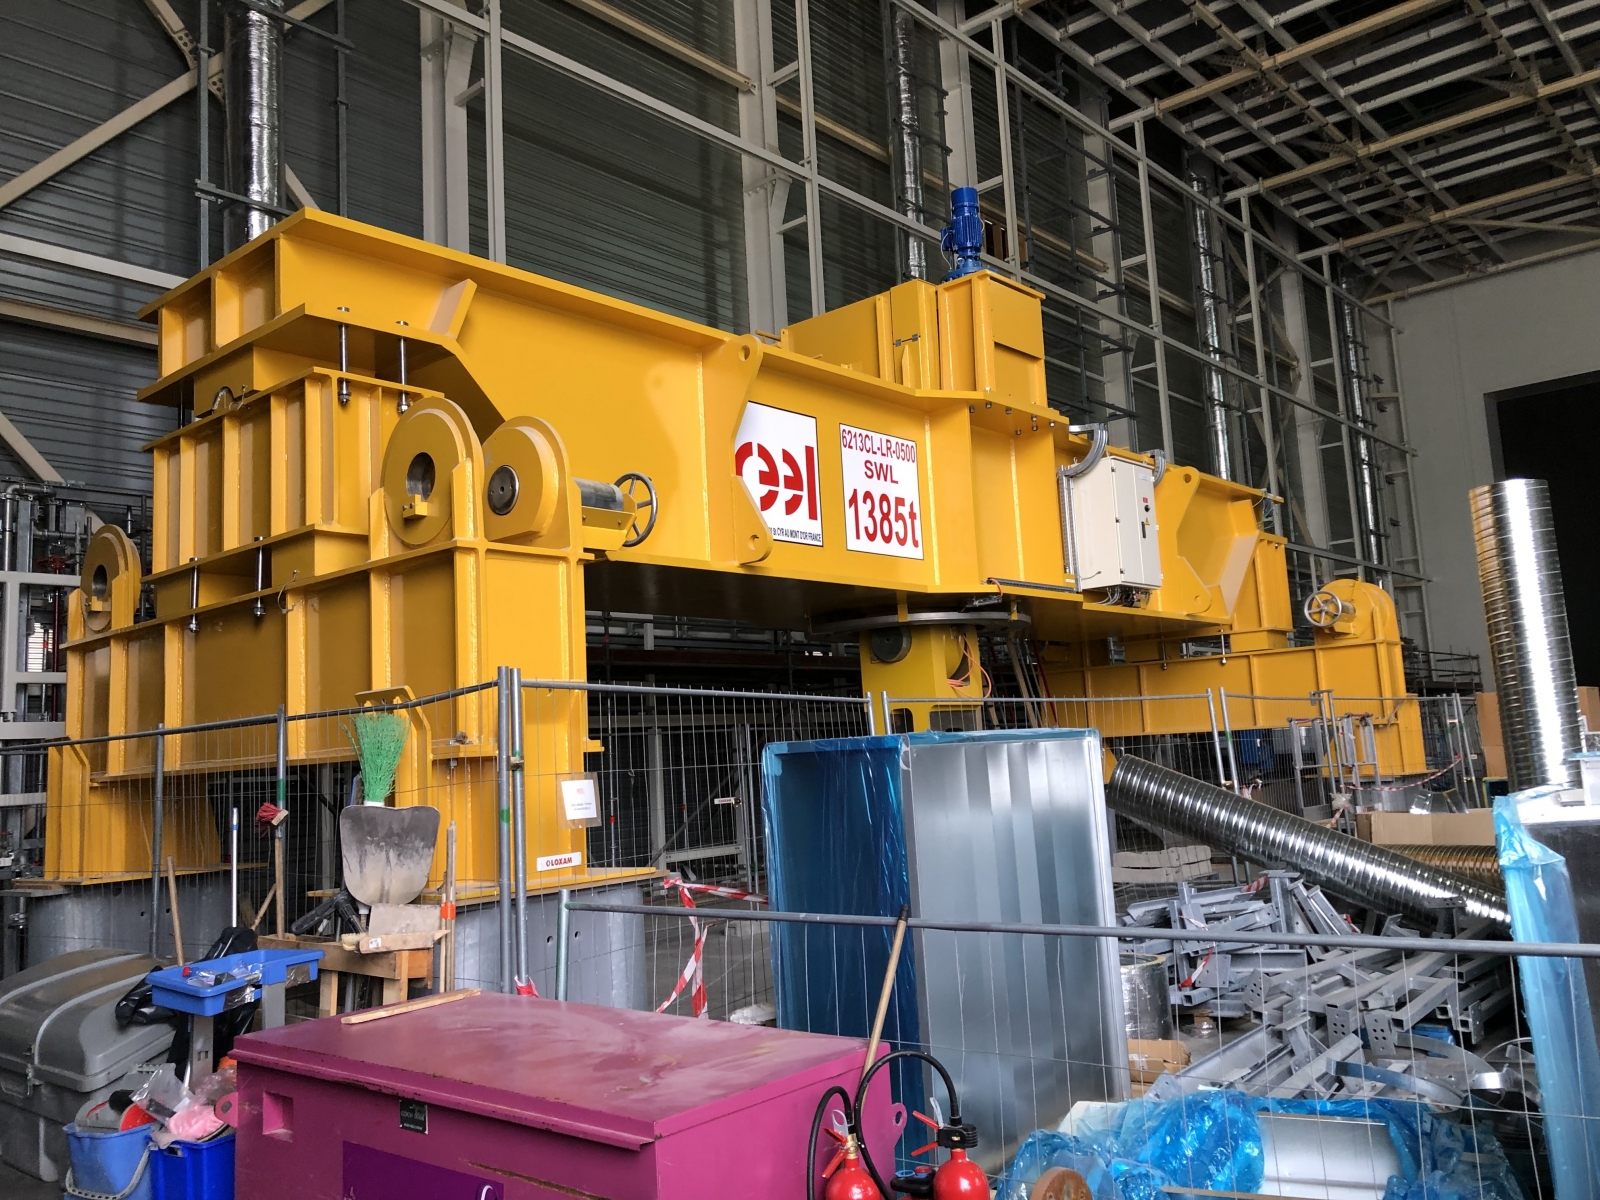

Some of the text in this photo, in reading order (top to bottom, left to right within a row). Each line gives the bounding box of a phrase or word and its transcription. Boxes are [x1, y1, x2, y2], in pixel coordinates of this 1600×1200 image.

[842, 429, 916, 463] 6213CL-LR-0500
[864, 459, 899, 484] SWL
[848, 488, 919, 548] 1385t
